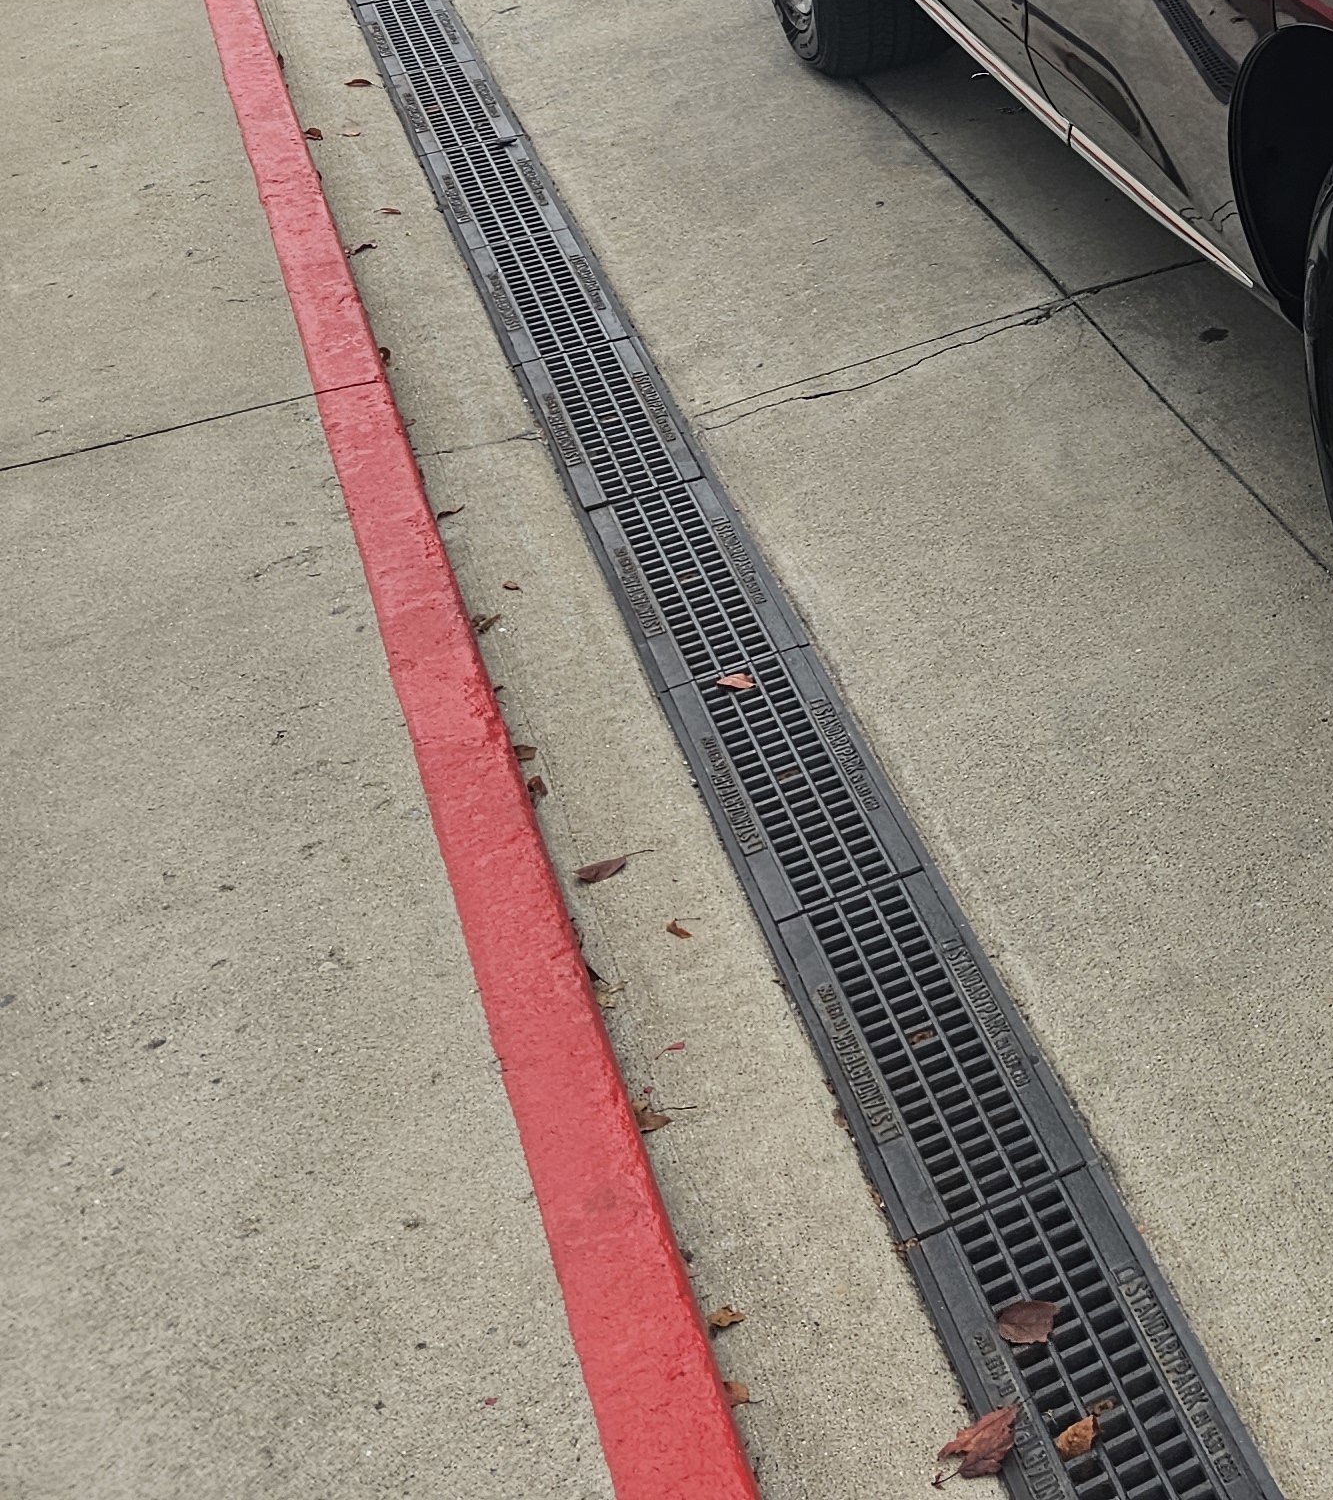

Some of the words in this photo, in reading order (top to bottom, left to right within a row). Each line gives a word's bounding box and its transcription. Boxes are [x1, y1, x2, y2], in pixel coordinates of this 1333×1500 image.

[948, 947, 1011, 1039] STANDARTPARK
[832, 1028, 893, 1128] STANDARTPARK
[1125, 1280, 1209, 1412] STANDARTPARK
